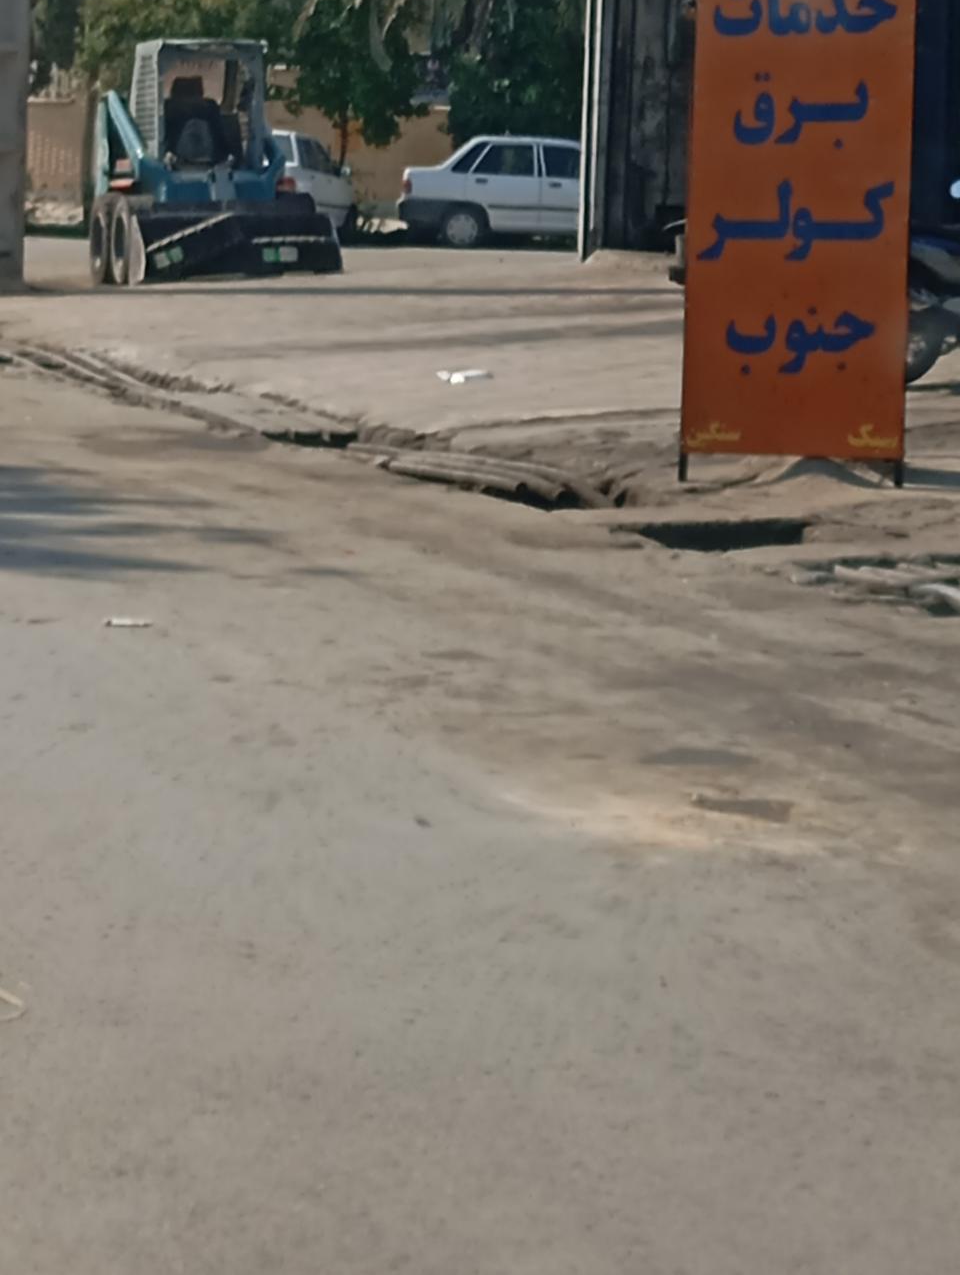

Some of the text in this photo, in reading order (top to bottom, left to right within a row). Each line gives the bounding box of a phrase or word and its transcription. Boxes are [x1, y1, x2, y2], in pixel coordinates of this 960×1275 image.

[732, 73, 869, 150] برق
[697, 178, 895, 261] کولر
[725, 304, 877, 376] جنوب
